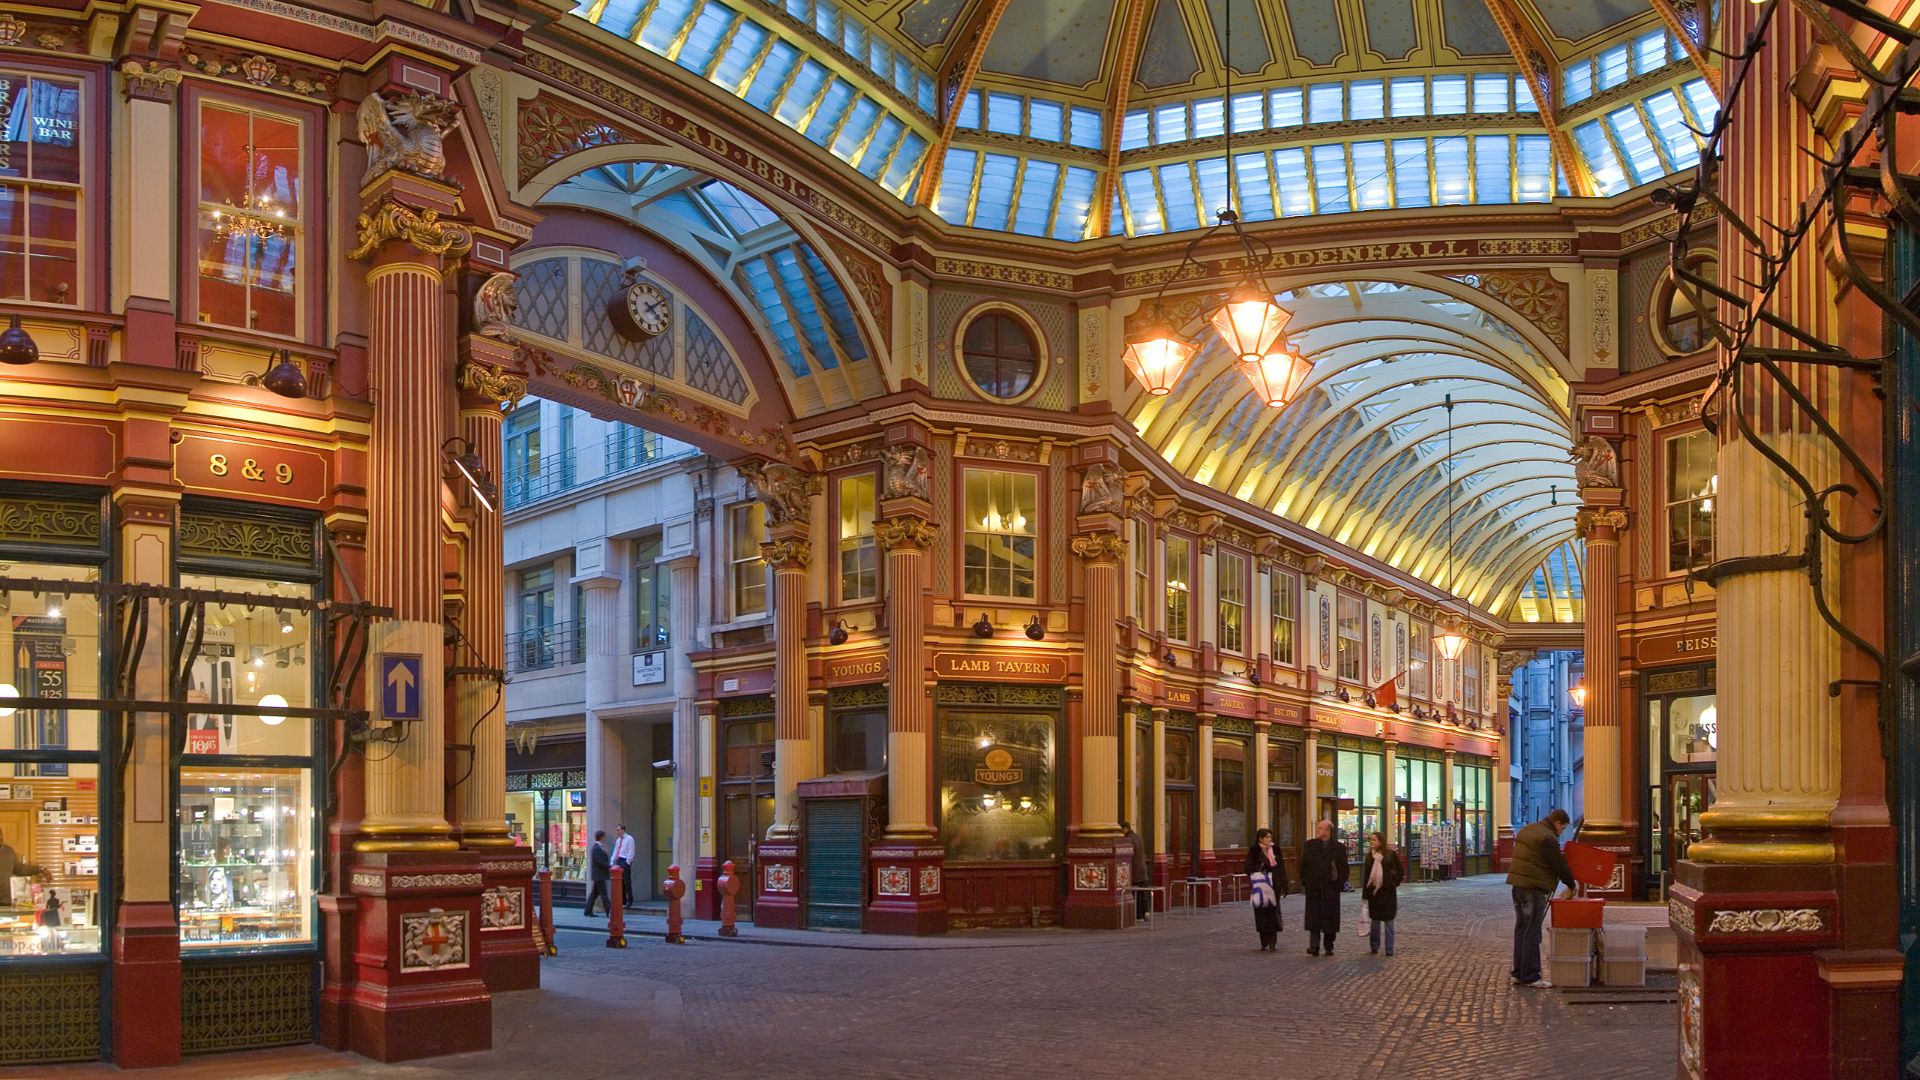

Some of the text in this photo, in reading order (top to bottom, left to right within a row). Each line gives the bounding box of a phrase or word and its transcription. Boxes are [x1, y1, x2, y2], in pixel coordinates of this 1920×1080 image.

[33, 116, 78, 130] WINE
[40, 128, 72, 140] BAR
[743, 152, 798, 196] 1881
[1218, 240, 1468, 275] LEADENHALL
[210, 454, 293, 485] 8 & 9
[832, 661, 881, 677] YOUNGS
[951, 660, 1051, 674] LAMB TAVERN
[38, 671, 62, 687] £55
[1168, 691, 1190, 702] LAMB
[1220, 698, 1245, 710] TAVERN
